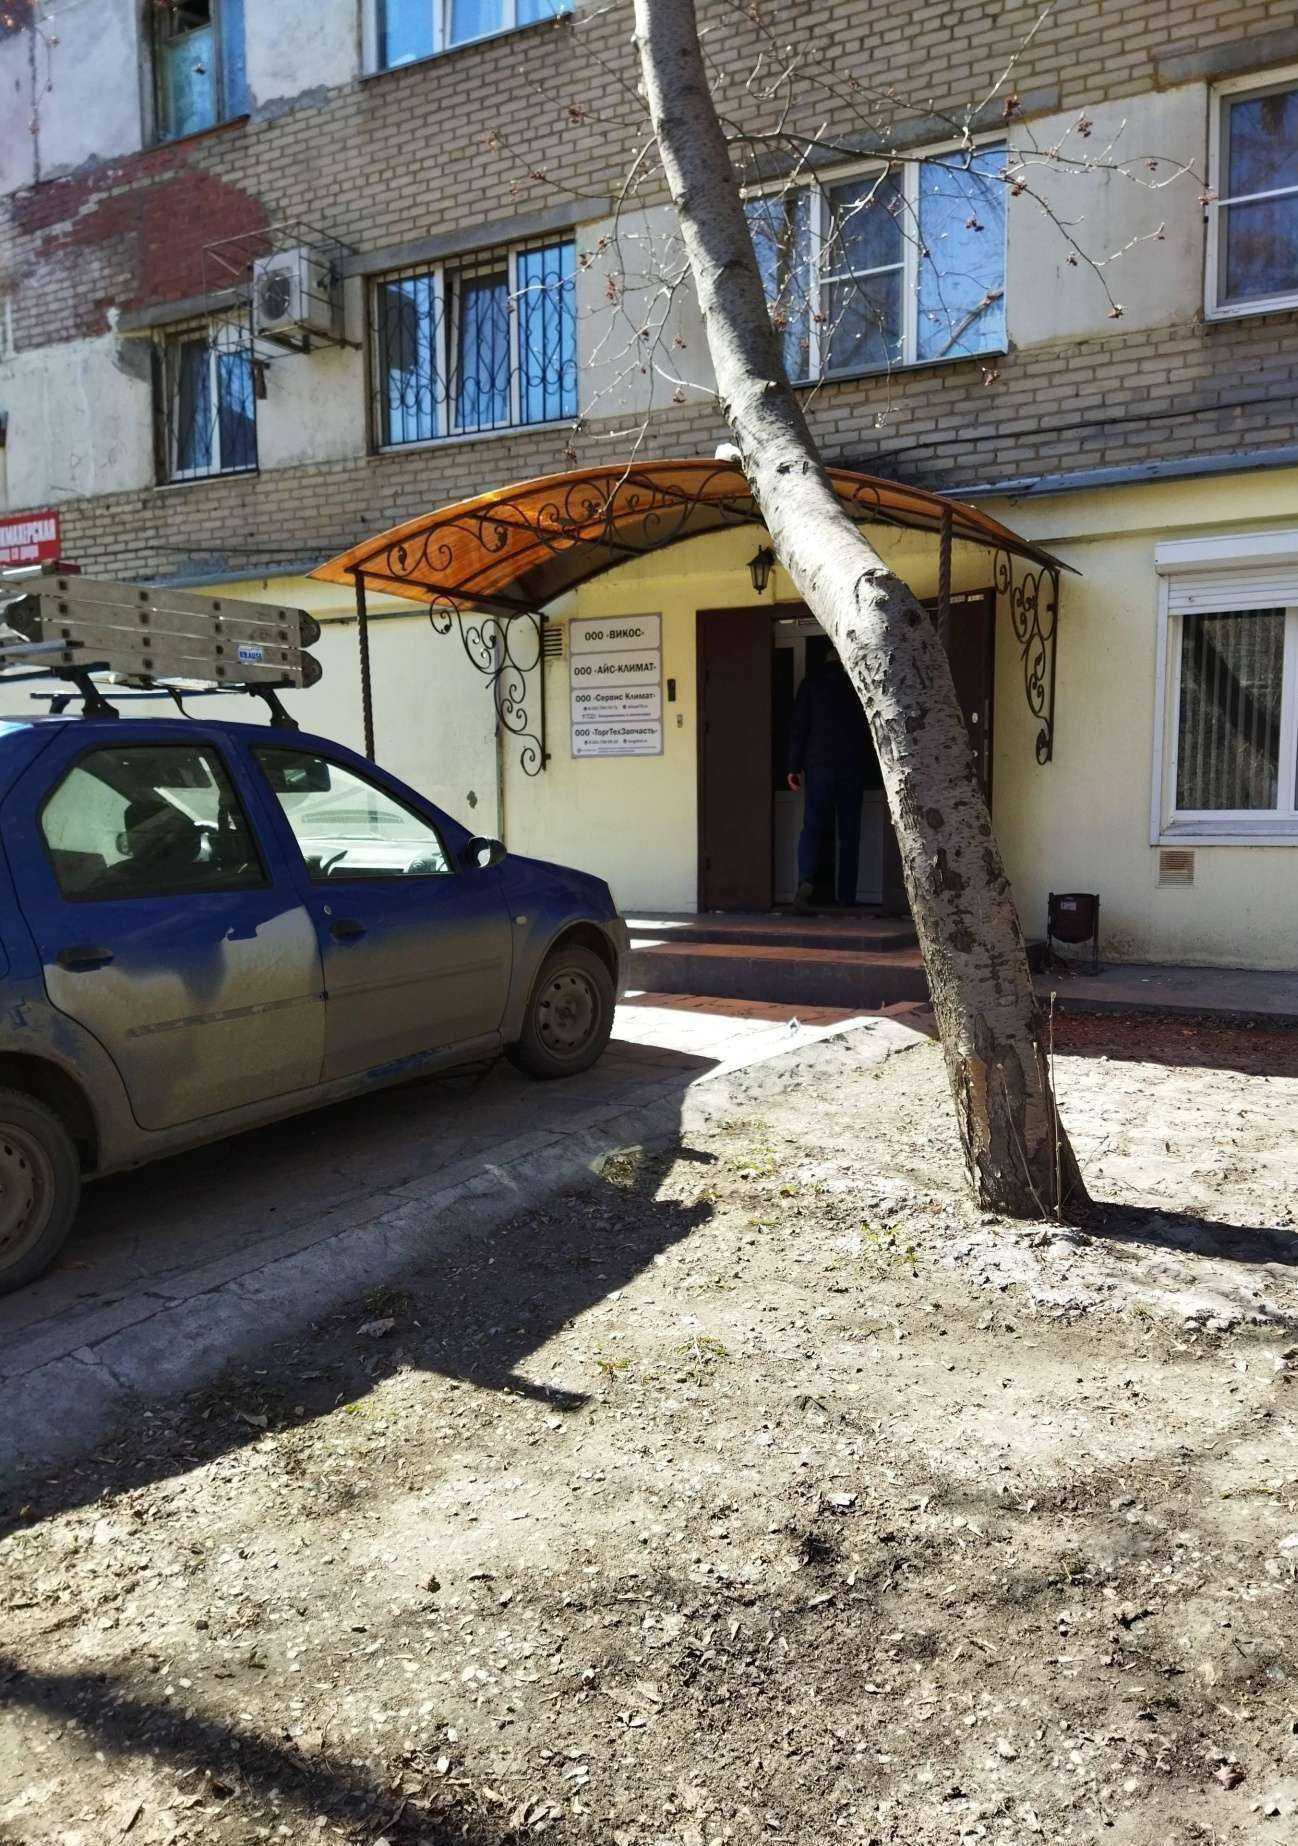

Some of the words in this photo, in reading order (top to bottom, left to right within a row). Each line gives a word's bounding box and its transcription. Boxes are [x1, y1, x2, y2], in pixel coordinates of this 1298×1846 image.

[585, 631, 604, 641] ООО
[574, 666, 592, 676] ООО
[575, 694, 591, 702] ООО
